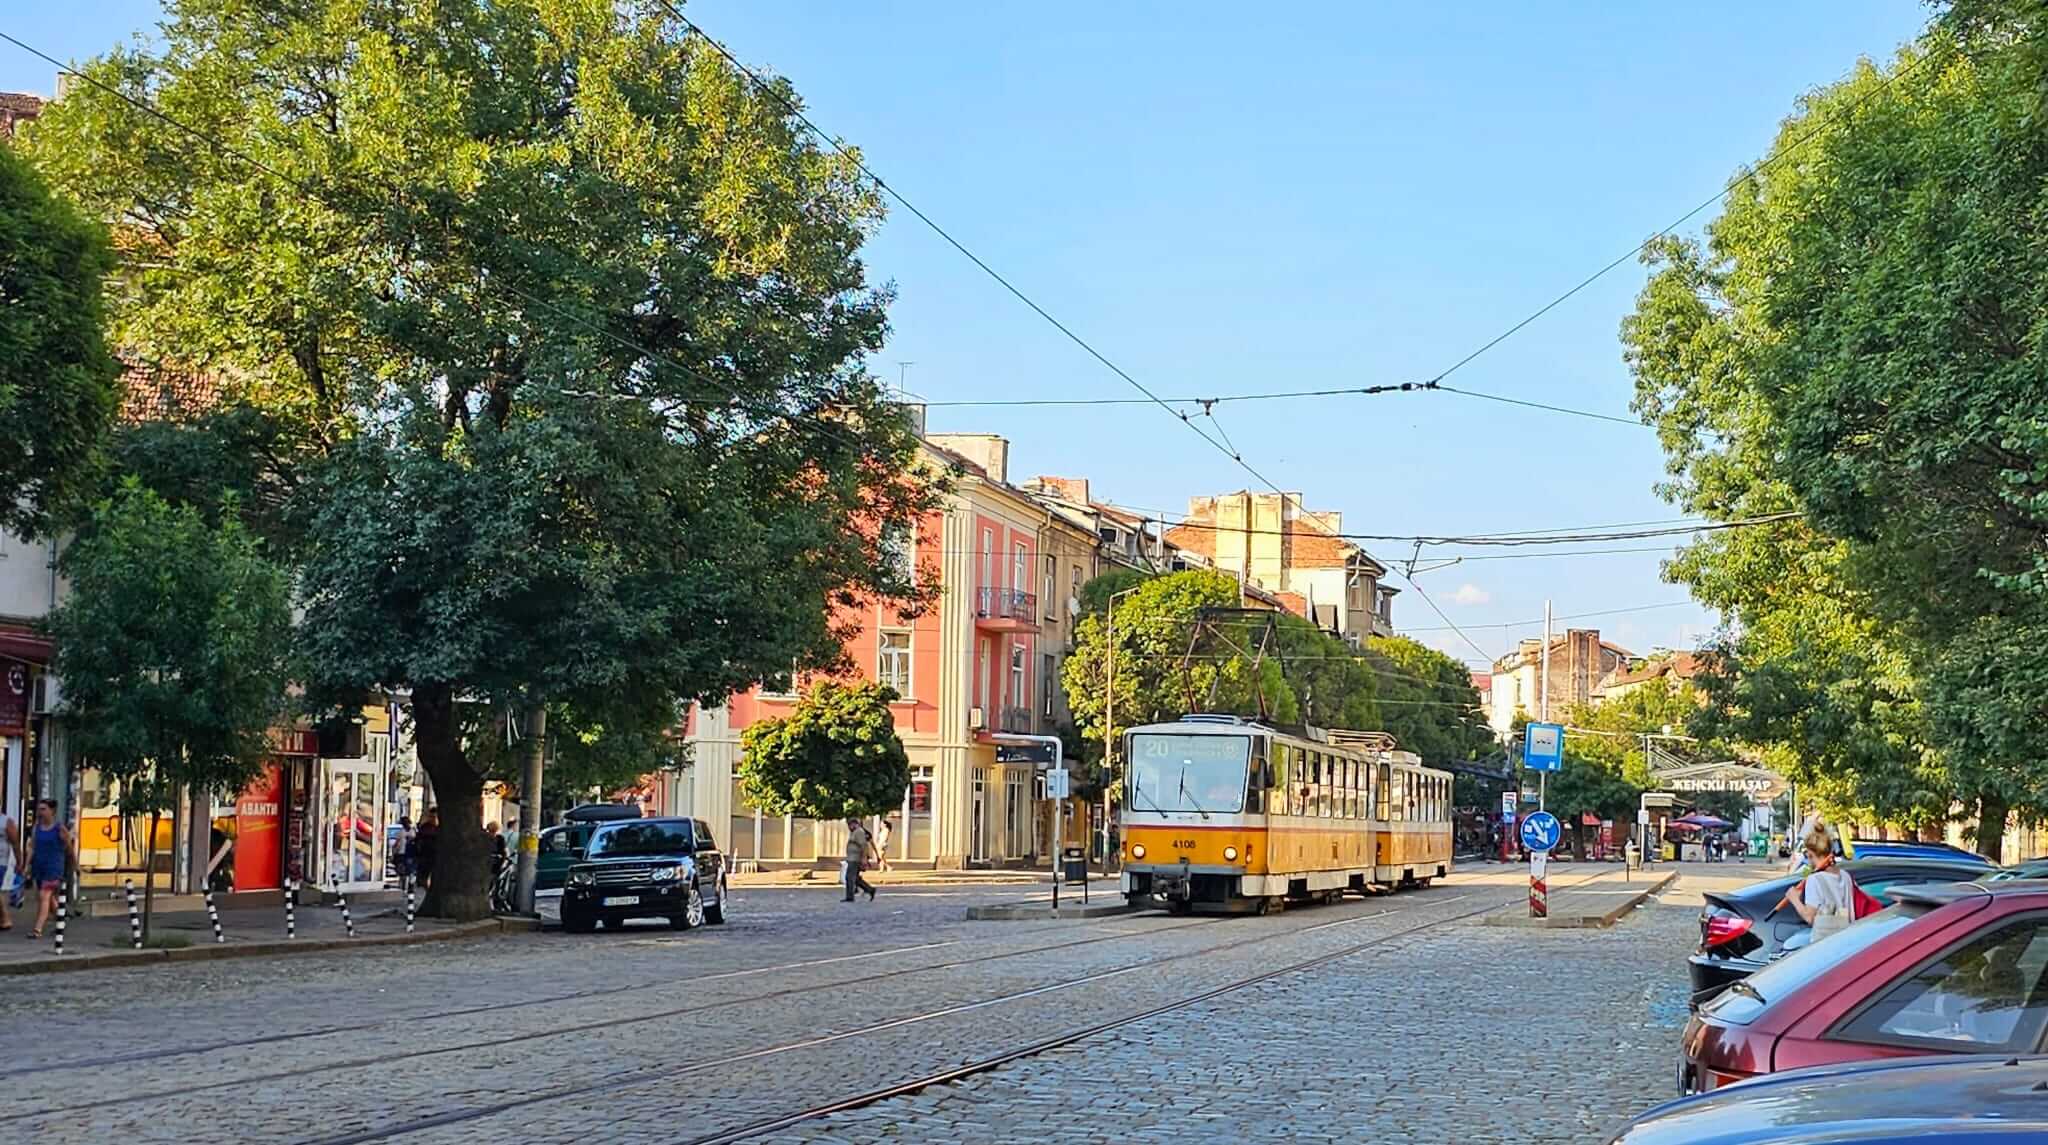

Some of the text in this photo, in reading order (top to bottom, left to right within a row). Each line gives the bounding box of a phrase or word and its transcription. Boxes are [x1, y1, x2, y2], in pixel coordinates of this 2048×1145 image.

[1147, 740, 1168, 756] 20
[1729, 780, 1771, 791] ПАЗАР
[241, 803, 278, 816] АВАНТИ
